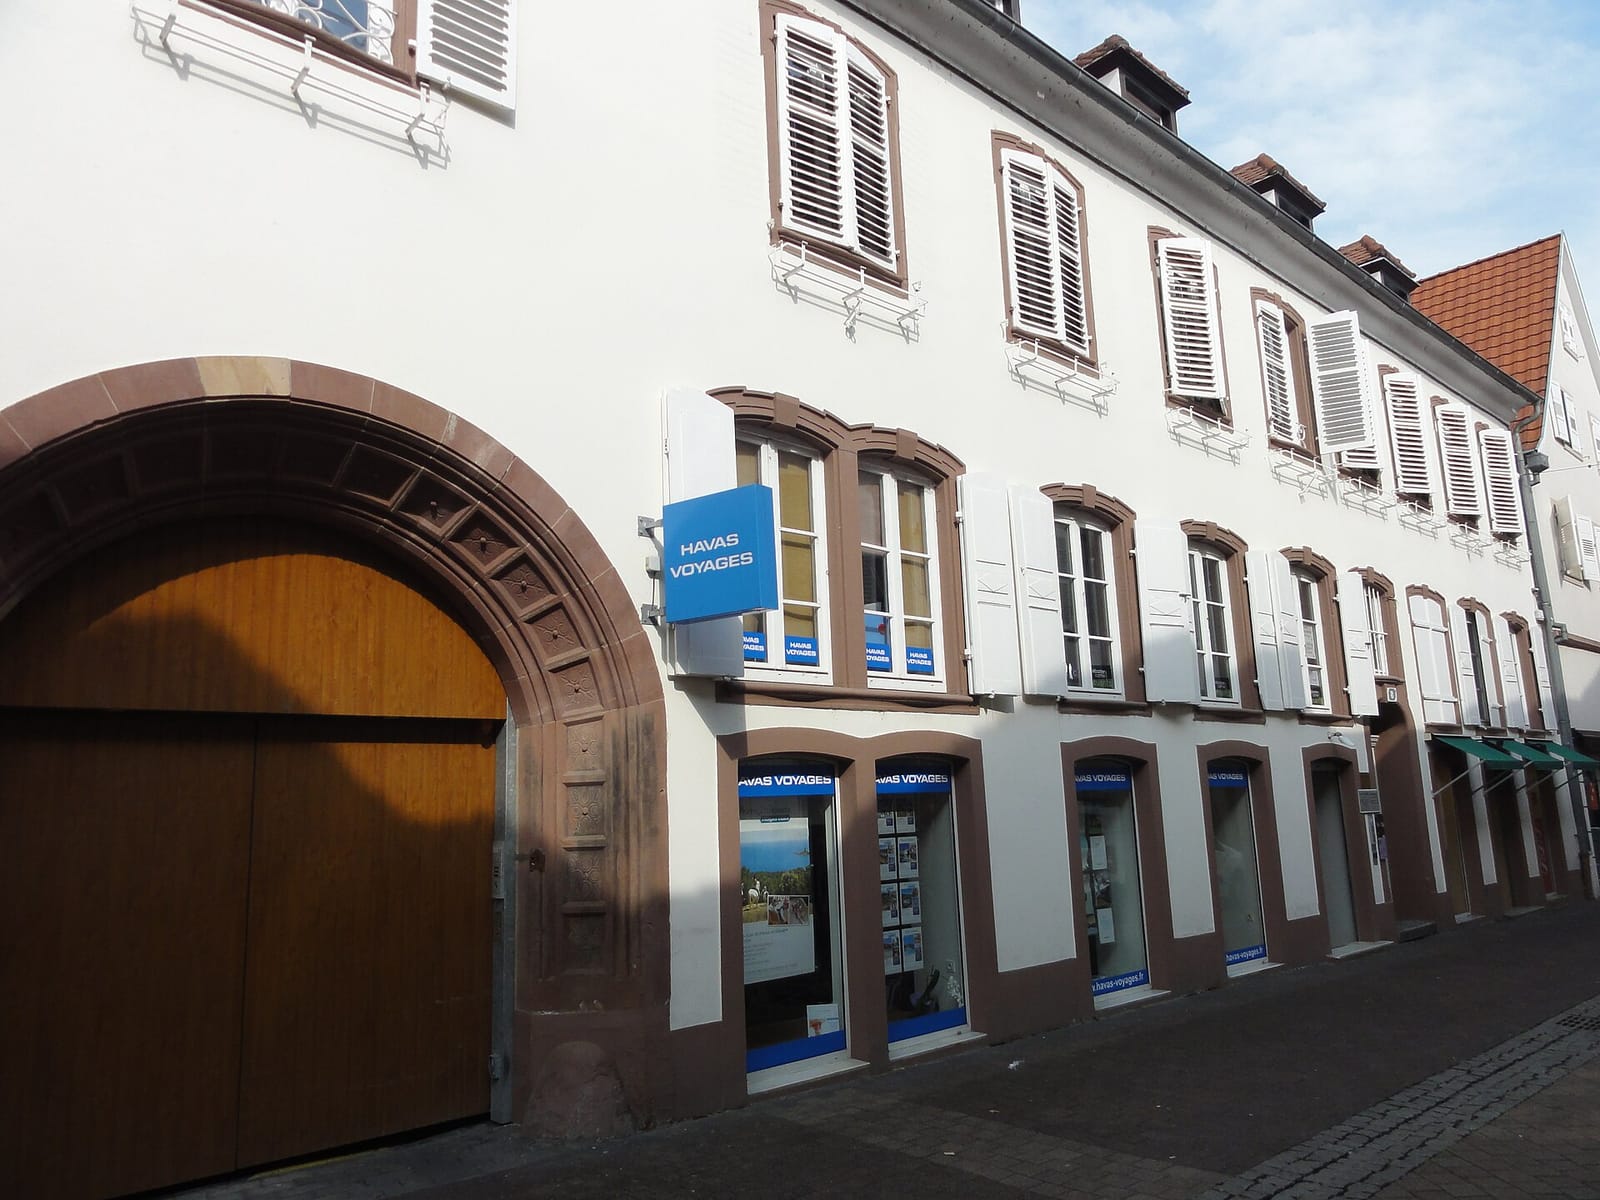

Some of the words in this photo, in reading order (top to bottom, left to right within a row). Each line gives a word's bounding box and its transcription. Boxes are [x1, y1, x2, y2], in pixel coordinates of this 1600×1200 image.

[681, 533, 739, 556] HAVAS
[669, 552, 753, 578] VOYAGES
[790, 641, 812, 649] HAVAS
[774, 775, 832, 786] VOYAGES
[901, 774, 948, 783] VOYAGES
